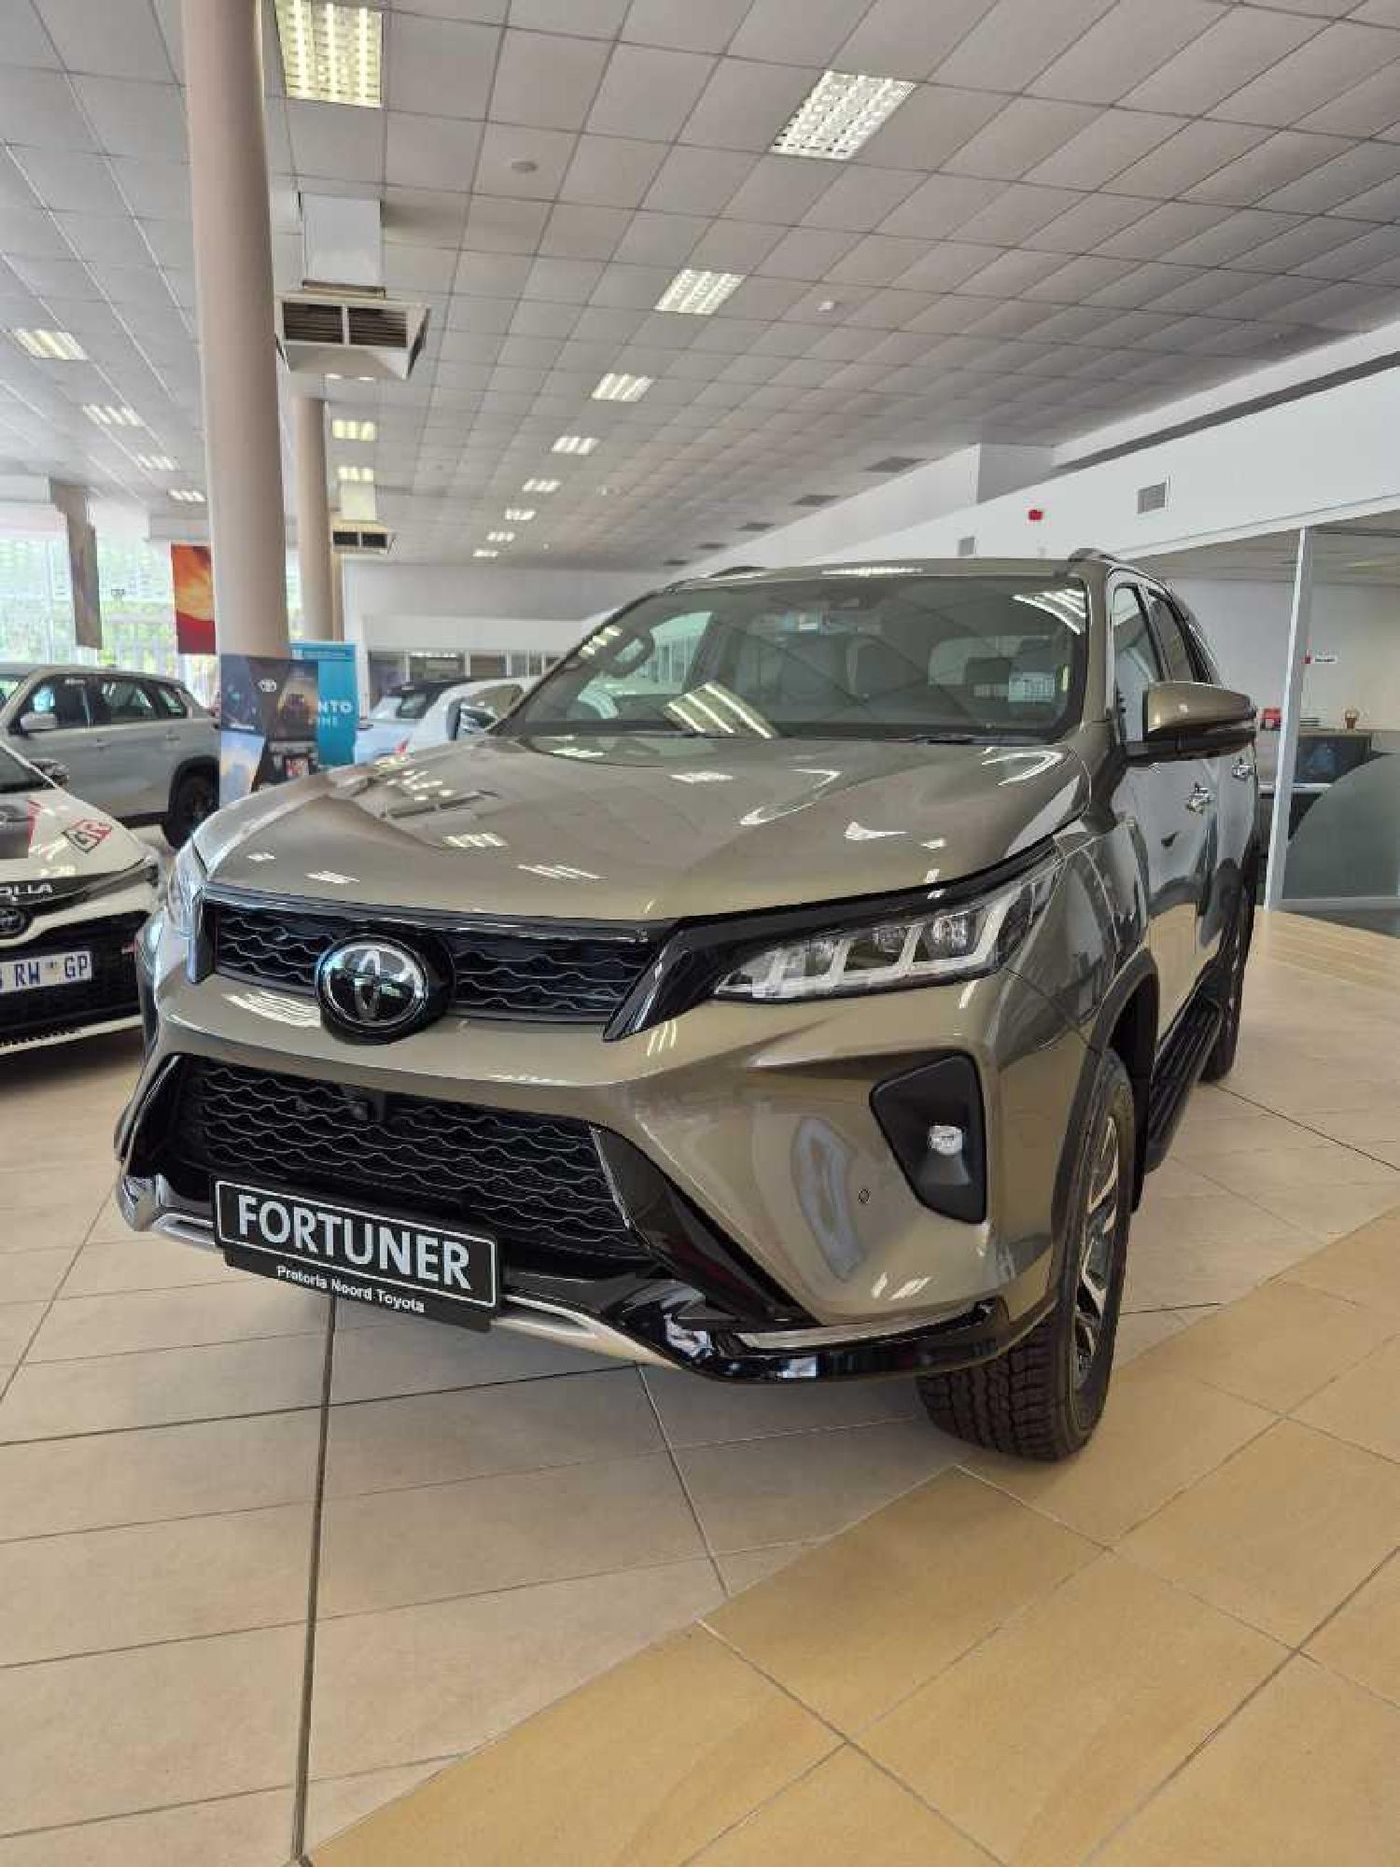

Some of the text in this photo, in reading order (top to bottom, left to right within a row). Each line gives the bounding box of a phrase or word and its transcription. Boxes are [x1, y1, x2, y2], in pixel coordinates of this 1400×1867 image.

[64, 955, 88, 978] GP
[238, 1194, 472, 1290] FORTUNER
[277, 1265, 425, 1313] Pretoria Noord Toyota
